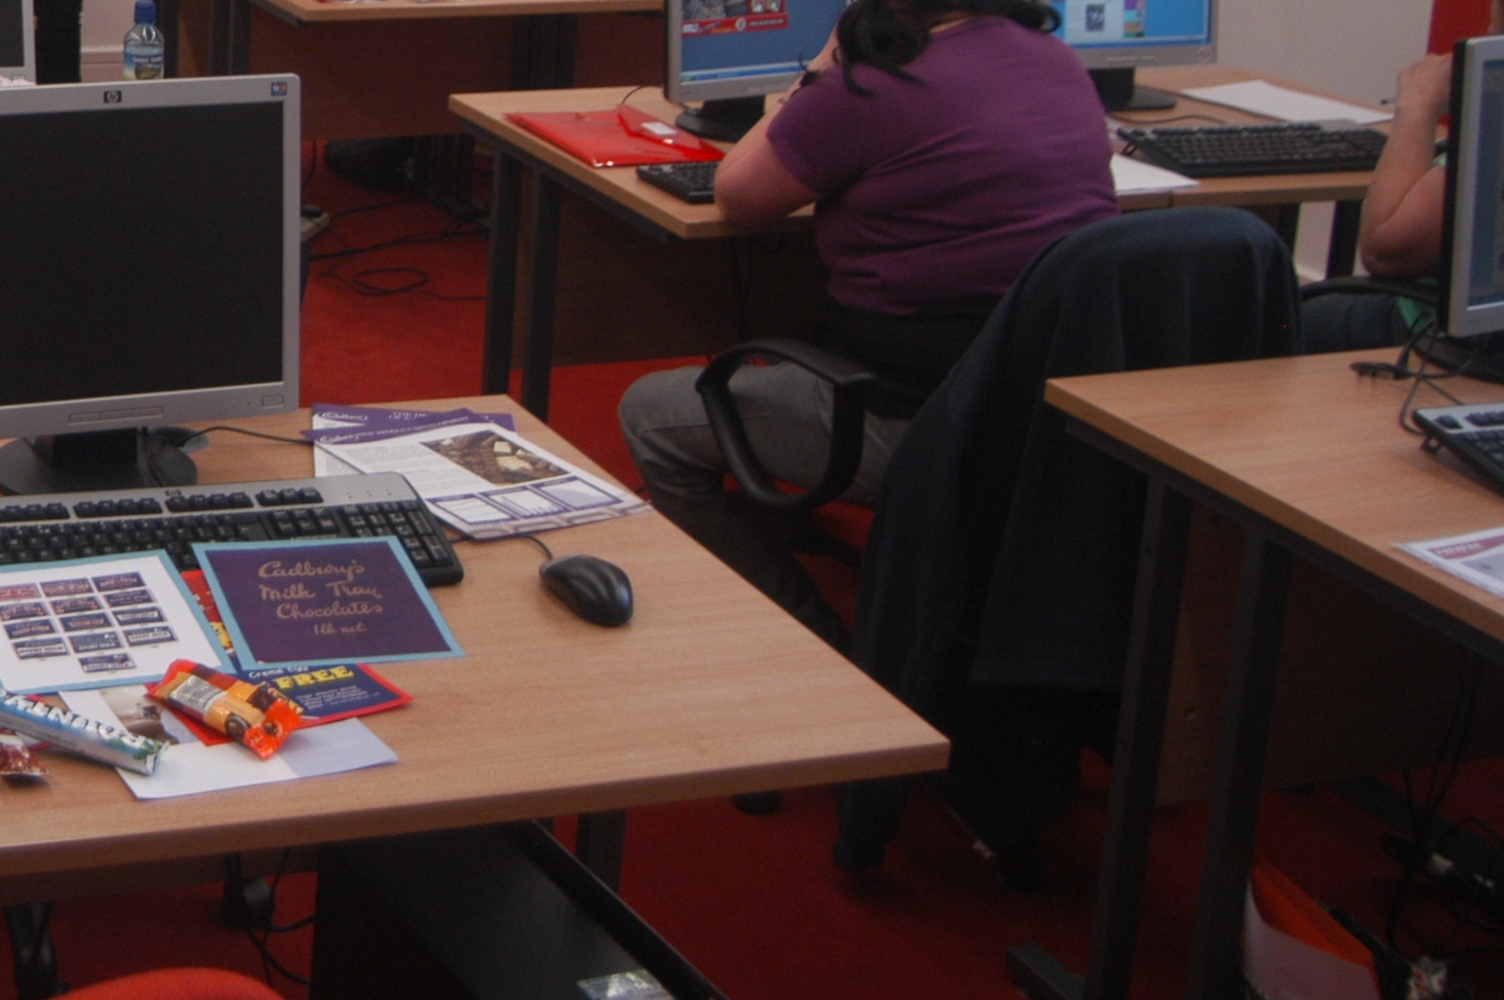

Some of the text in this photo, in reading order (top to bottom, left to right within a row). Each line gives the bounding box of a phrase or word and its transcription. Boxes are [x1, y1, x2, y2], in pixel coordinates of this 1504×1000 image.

[258, 560, 365, 581] Cadbury's
[258, 579, 382, 600] Milk Tray
[276, 600, 384, 619] Chocolates
[273, 665, 355, 690] FREE
[4, 694, 148, 750] BOUNTY
